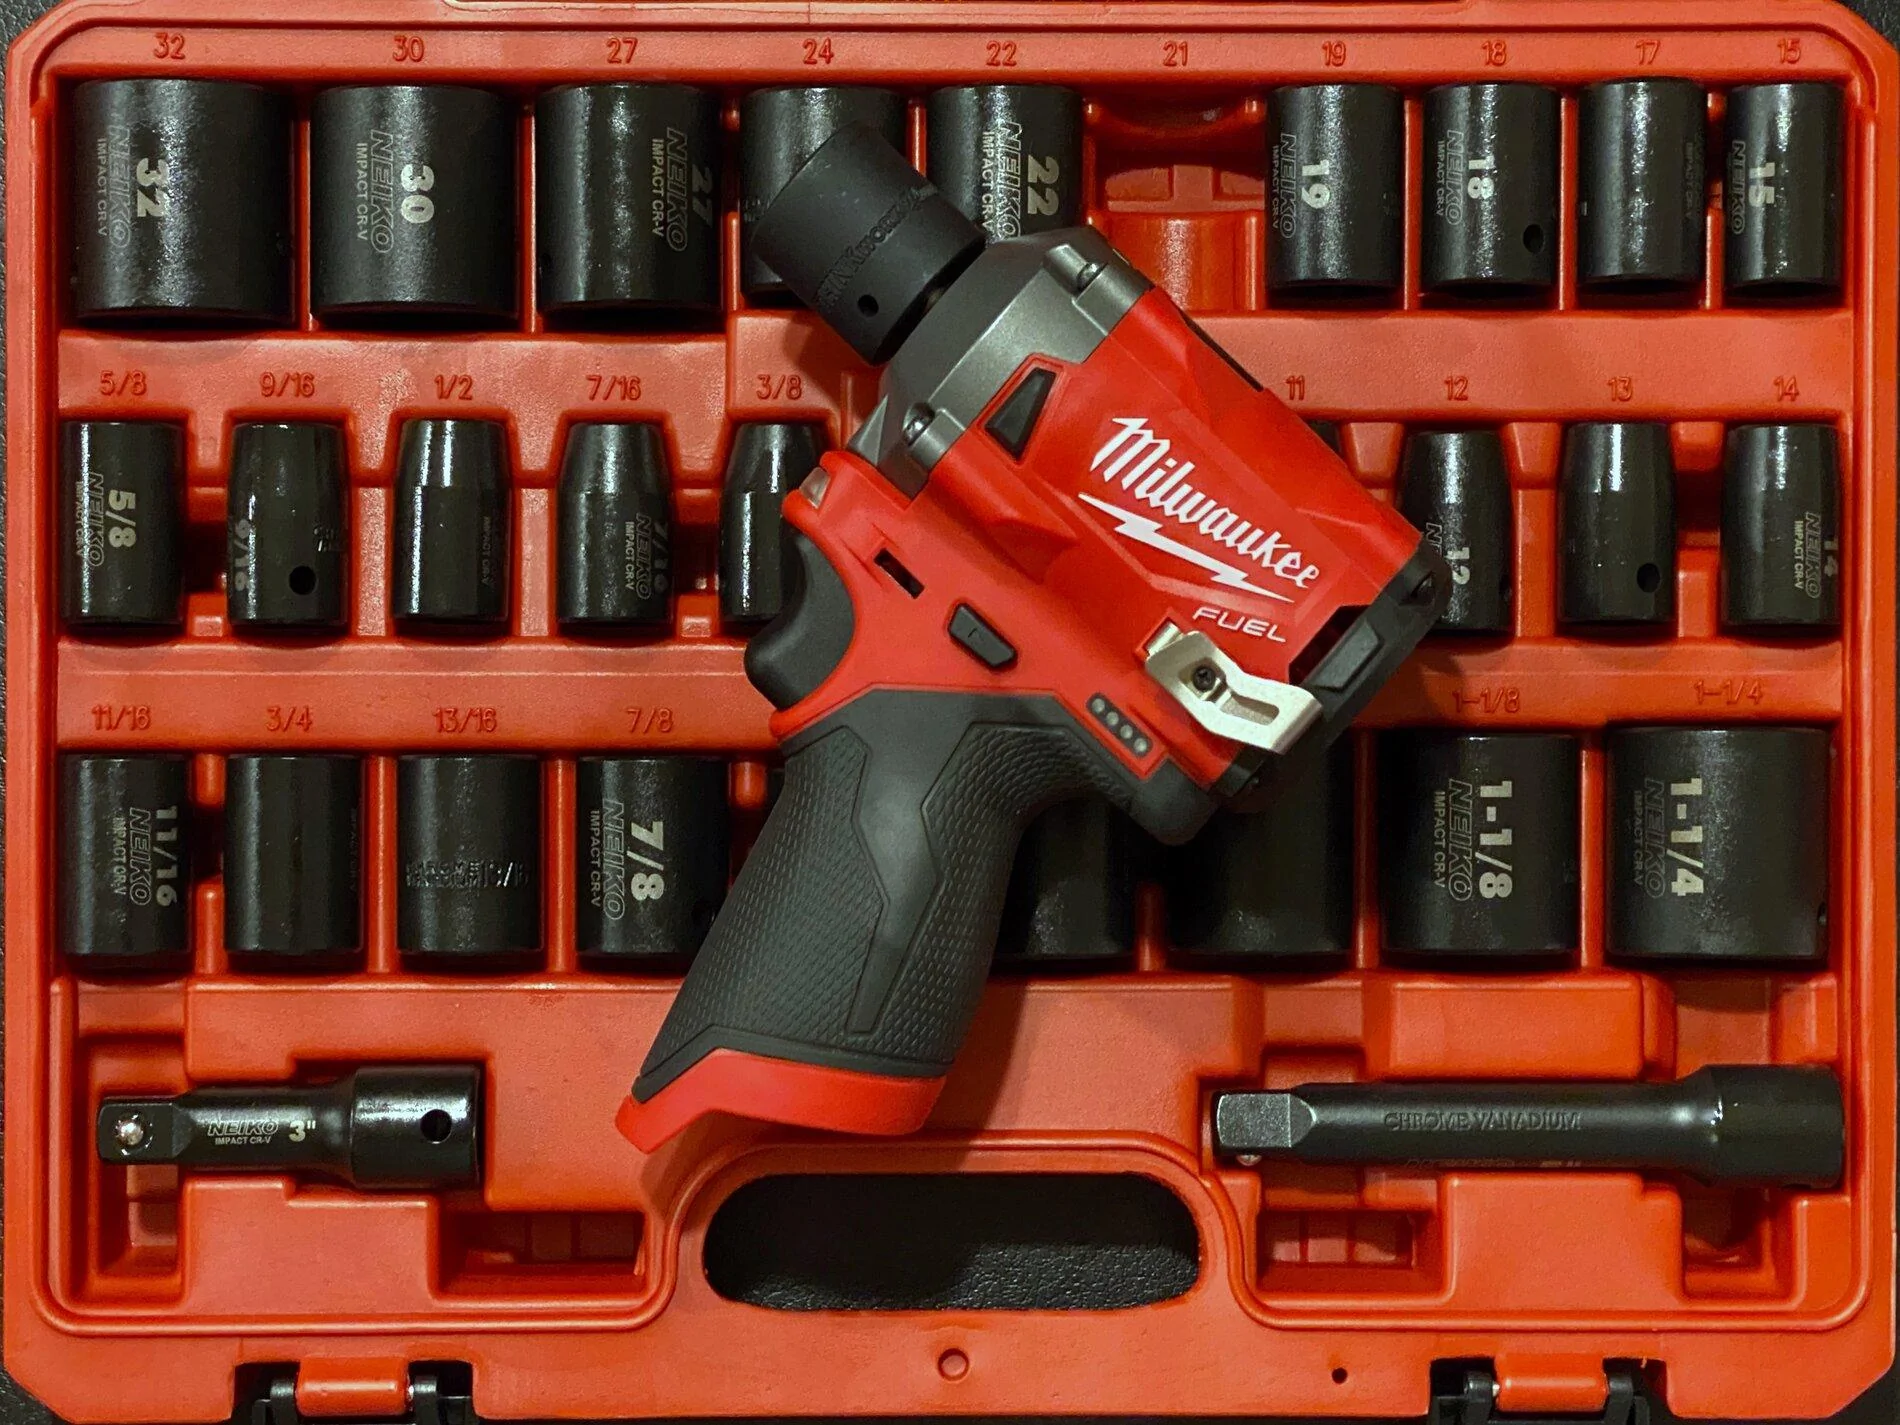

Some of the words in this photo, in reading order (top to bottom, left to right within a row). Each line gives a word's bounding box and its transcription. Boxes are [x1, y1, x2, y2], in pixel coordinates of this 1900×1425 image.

[153, 33, 186, 60] 32
[392, 35, 425, 62] 30
[606, 37, 638, 64] 27
[802, 37, 834, 65] 24
[985, 40, 1017, 66] 22
[1163, 40, 1189, 67] 21
[1322, 40, 1346, 66] 19
[1482, 40, 1507, 66] 18
[1635, 38, 1661, 65] 17
[1777, 38, 1801, 64] 15
[97, 138, 106, 196] IMPACT
[357, 143, 367, 201] IMPACT
[651, 138, 664, 196] IMPACT
[982, 131, 995, 189] IMPACT
[998, 119, 1022, 238] NEIKO
[1437, 140, 1445, 188] IMPACT
[1445, 130, 1465, 226] NEIKO
[1467, 156, 1494, 199] 18
[108, 126, 131, 249] NEIKO
[137, 157, 169, 218] 32
[370, 130, 394, 254] NEIKO
[400, 164, 435, 224] 30
[666, 126, 688, 251] NEIKO
[692, 164, 713, 227] 27
[1028, 154, 1059, 215] 22
[1280, 133, 1297, 238] NEIKO
[1302, 160, 1331, 209] 19
[1437, 189, 1445, 217] CR-V
[1732, 140, 1746, 234] NEIKO
[1749, 162, 1775, 208] 15
[97, 199, 106, 237] CR-V
[357, 204, 367, 241] CR-V
[651, 199, 664, 237] CR-V
[100, 370, 147, 396] 5/8
[259, 371, 315, 397] 9/16
[434, 374, 473, 400] 1/2
[586, 374, 641, 400] 7/16
[756, 374, 802, 400] 3/8
[1285, 375, 1305, 401] 11
[1443, 375, 1468, 401] 12
[1607, 376, 1633, 402] 13
[1774, 376, 1799, 402] 14
[86, 471, 105, 567] NEIKO
[106, 489, 137, 548] 5/8
[1090, 417, 1320, 588] Milwaukee
[625, 521, 635, 562] IMPACT
[635, 512, 652, 600] NEIKO
[1794, 520, 1804, 560] IMPACT
[1805, 511, 1821, 598] NEIKO
[625, 564, 635, 590] CR-V
[1192, 605, 1287, 643] FUEL
[1452, 686, 1520, 714] 1-1/8
[1694, 678, 1763, 706] 1-1/4
[91, 705, 150, 731] 11/16
[265, 706, 313, 732] 3/4
[432, 707, 497, 733] 13/16
[626, 708, 674, 733] 7/8
[1433, 791, 1445, 847] IMPACT
[1634, 791, 1644, 843] IMPACT
[1667, 777, 1704, 897] 1-1/4
[113, 816, 127, 864] IMPACT
[129, 807, 151, 906] NEIKO
[153, 805, 178, 907] 11/16
[590, 810, 601, 868] IMPACT
[1448, 778, 1472, 901] NEIKO
[1475, 780, 1513, 899] 1-1/8
[1644, 778, 1665, 898] NEIKO
[602, 800, 625, 920] NEIKO
[627, 820, 665, 900] 7/8
[1433, 850, 1445, 888] CR-V
[590, 871, 601, 908] CR-V
[207, 1120, 279, 1136] NEIKO
[289, 1120, 317, 1142] 3"
[214, 1136, 248, 1145] IMPACT
[250, 1136, 272, 1145] CR-V
[1384, 1111, 1472, 1131] CHROME
[1474, 1110, 1582, 1131] VANADIUM
